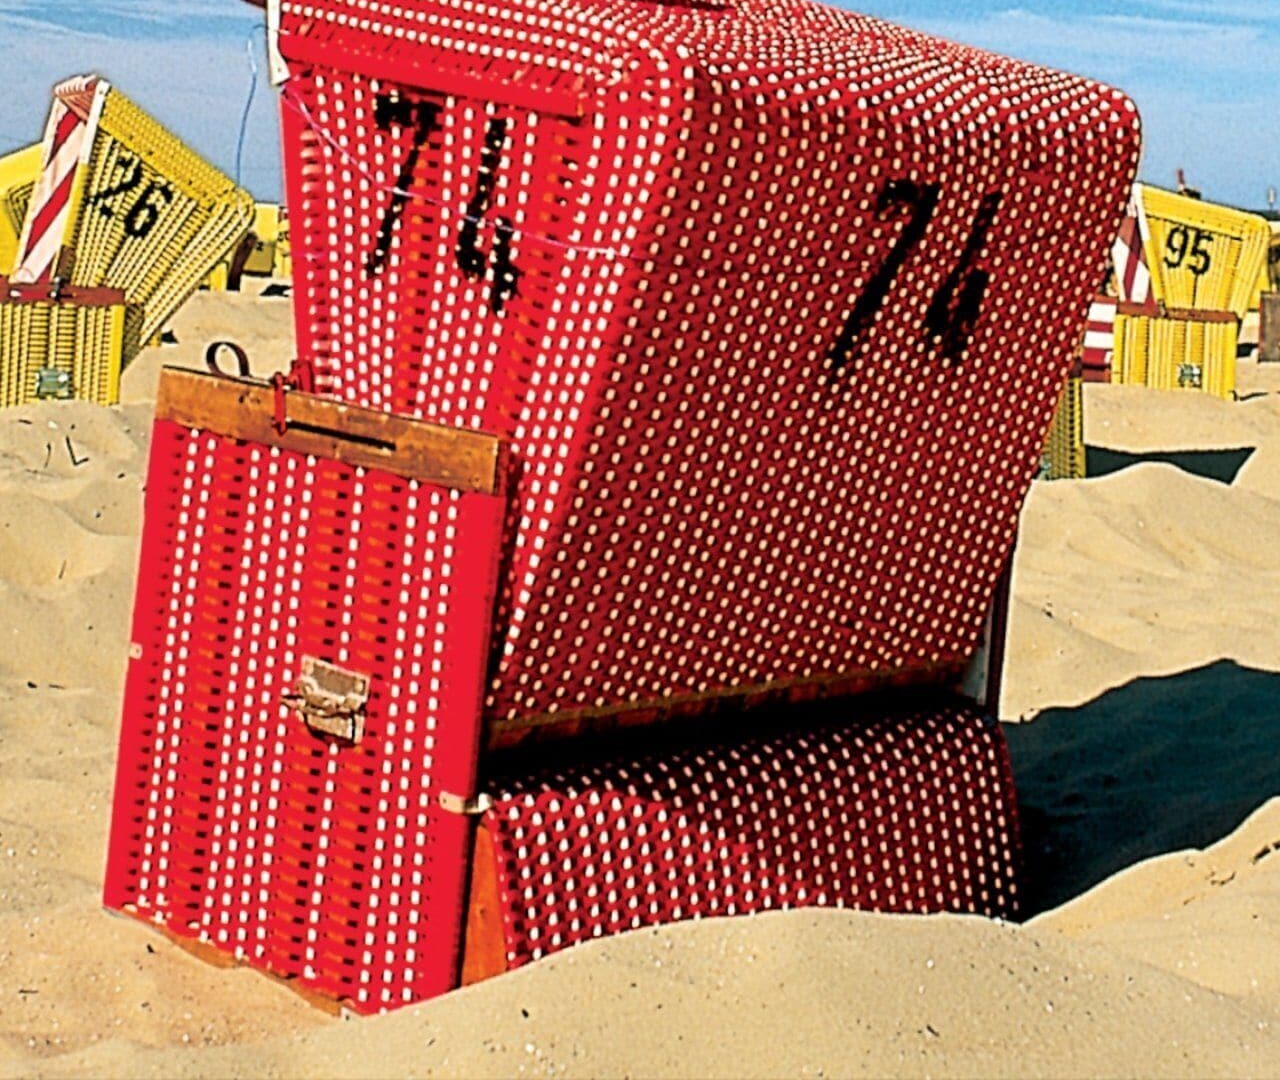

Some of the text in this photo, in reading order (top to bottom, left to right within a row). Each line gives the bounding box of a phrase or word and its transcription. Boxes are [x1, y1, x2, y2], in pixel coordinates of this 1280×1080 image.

[83, 155, 174, 239] 26
[365, 90, 519, 314] 74
[1163, 224, 1214, 276] 95
[825, 178, 1003, 369] 74
